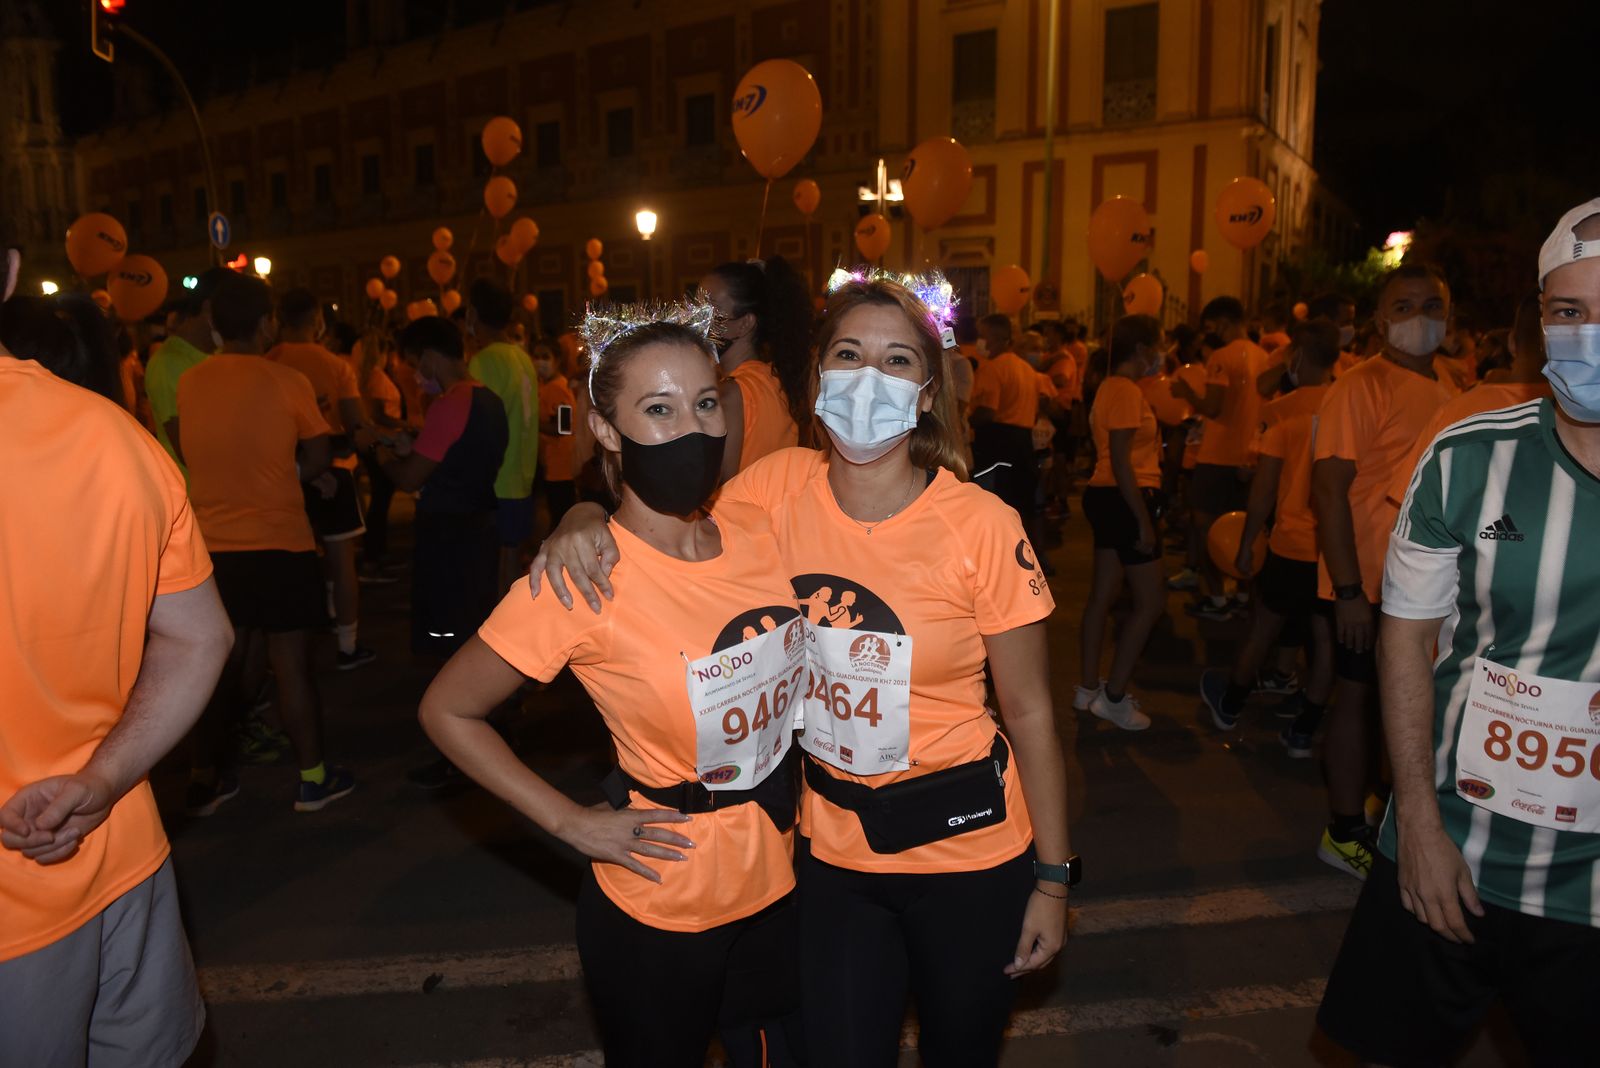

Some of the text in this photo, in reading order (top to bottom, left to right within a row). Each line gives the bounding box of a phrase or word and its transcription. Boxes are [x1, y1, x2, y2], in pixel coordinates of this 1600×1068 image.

[1479, 530, 1525, 542] adidas
[697, 652, 753, 682] NO8DO
[836, 671, 879, 683] GUADALQUIVIR
[879, 677, 891, 685] KH7
[716, 695, 741, 709] CARRERA
[741, 680, 769, 697] NOCTURNA
[768, 675, 778, 683] DEL
[1486, 671, 1542, 698] NO8DO
[1488, 705, 1514, 720] CARRERA
[1515, 716, 1554, 730] NOCTURNA
[1554, 724, 1567, 732] DEL
